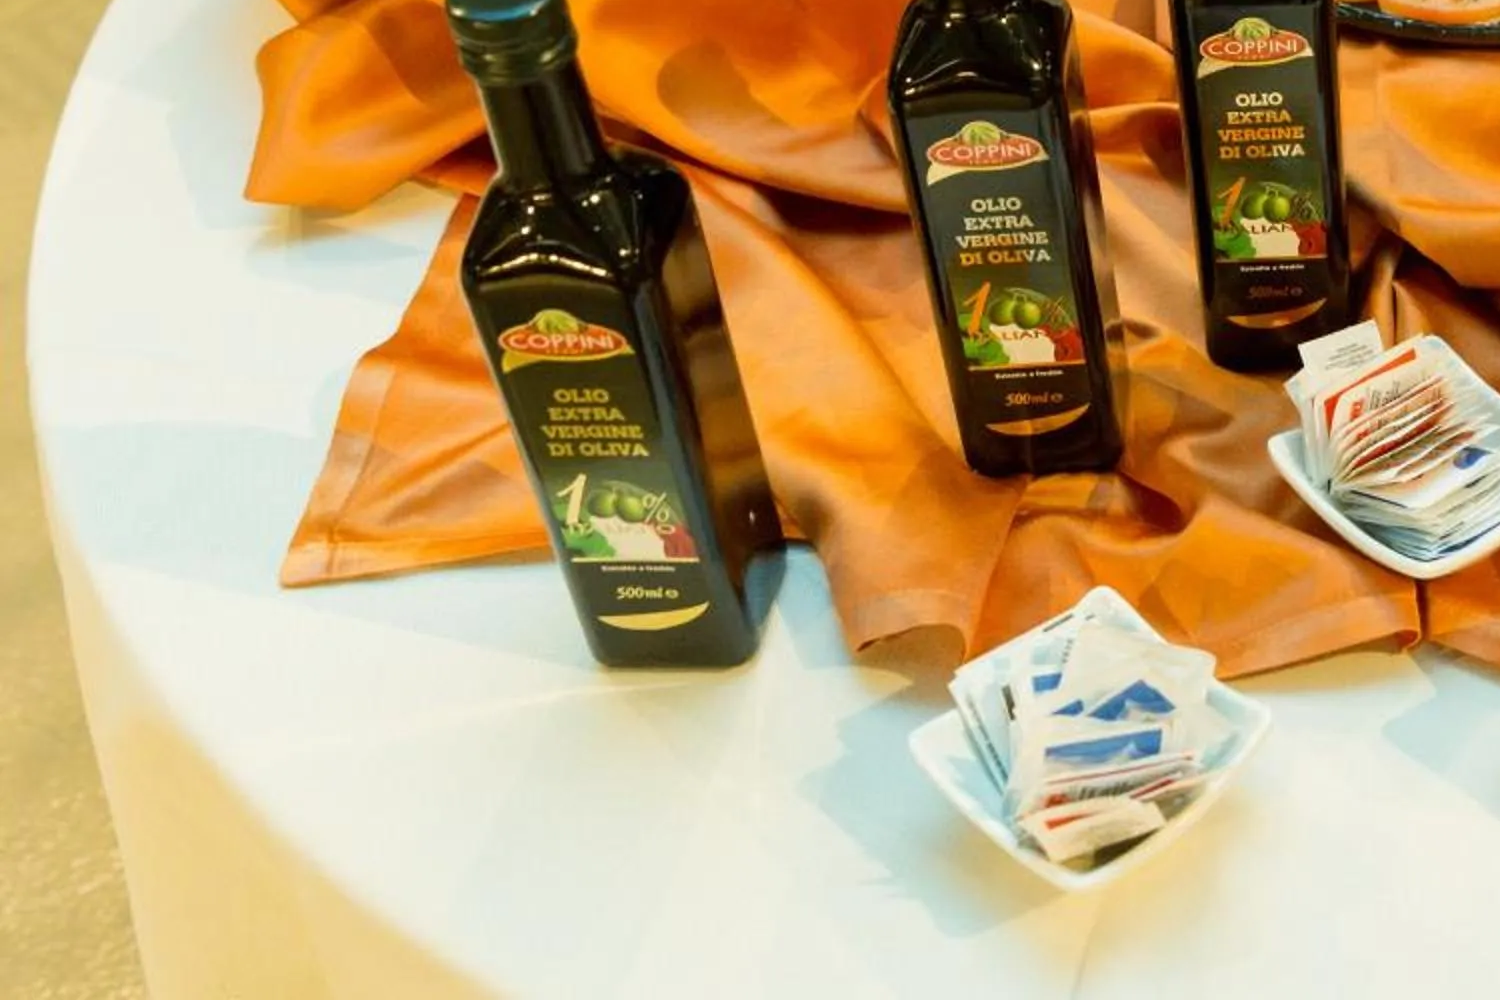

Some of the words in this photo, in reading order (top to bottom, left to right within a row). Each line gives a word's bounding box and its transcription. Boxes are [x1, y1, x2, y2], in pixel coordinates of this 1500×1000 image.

[1208, 39, 1297, 55] COPPINI
[1235, 92, 1283, 107] OLIO
[1226, 109, 1292, 125] EXTRA
[1217, 126, 1305, 143] VERGINE
[936, 143, 1032, 161] COPPINI
[1219, 146, 1241, 159] DI
[1245, 144, 1305, 159] OLIVA
[971, 197, 1022, 213] OLIO
[964, 215, 1034, 231] EXTRA
[955, 231, 1049, 249] VERGINE
[959, 251, 983, 266] DI
[987, 249, 1051, 265] OLIVA
[508, 333, 614, 350] COPPINI
[553, 388, 609, 403] OLIO
[548, 407, 625, 421] EXTRA
[540, 425, 643, 439] VERGINE
[547, 443, 575, 457] DI
[579, 442, 649, 457] OLIVA
[616, 585, 663, 600] 500ml
